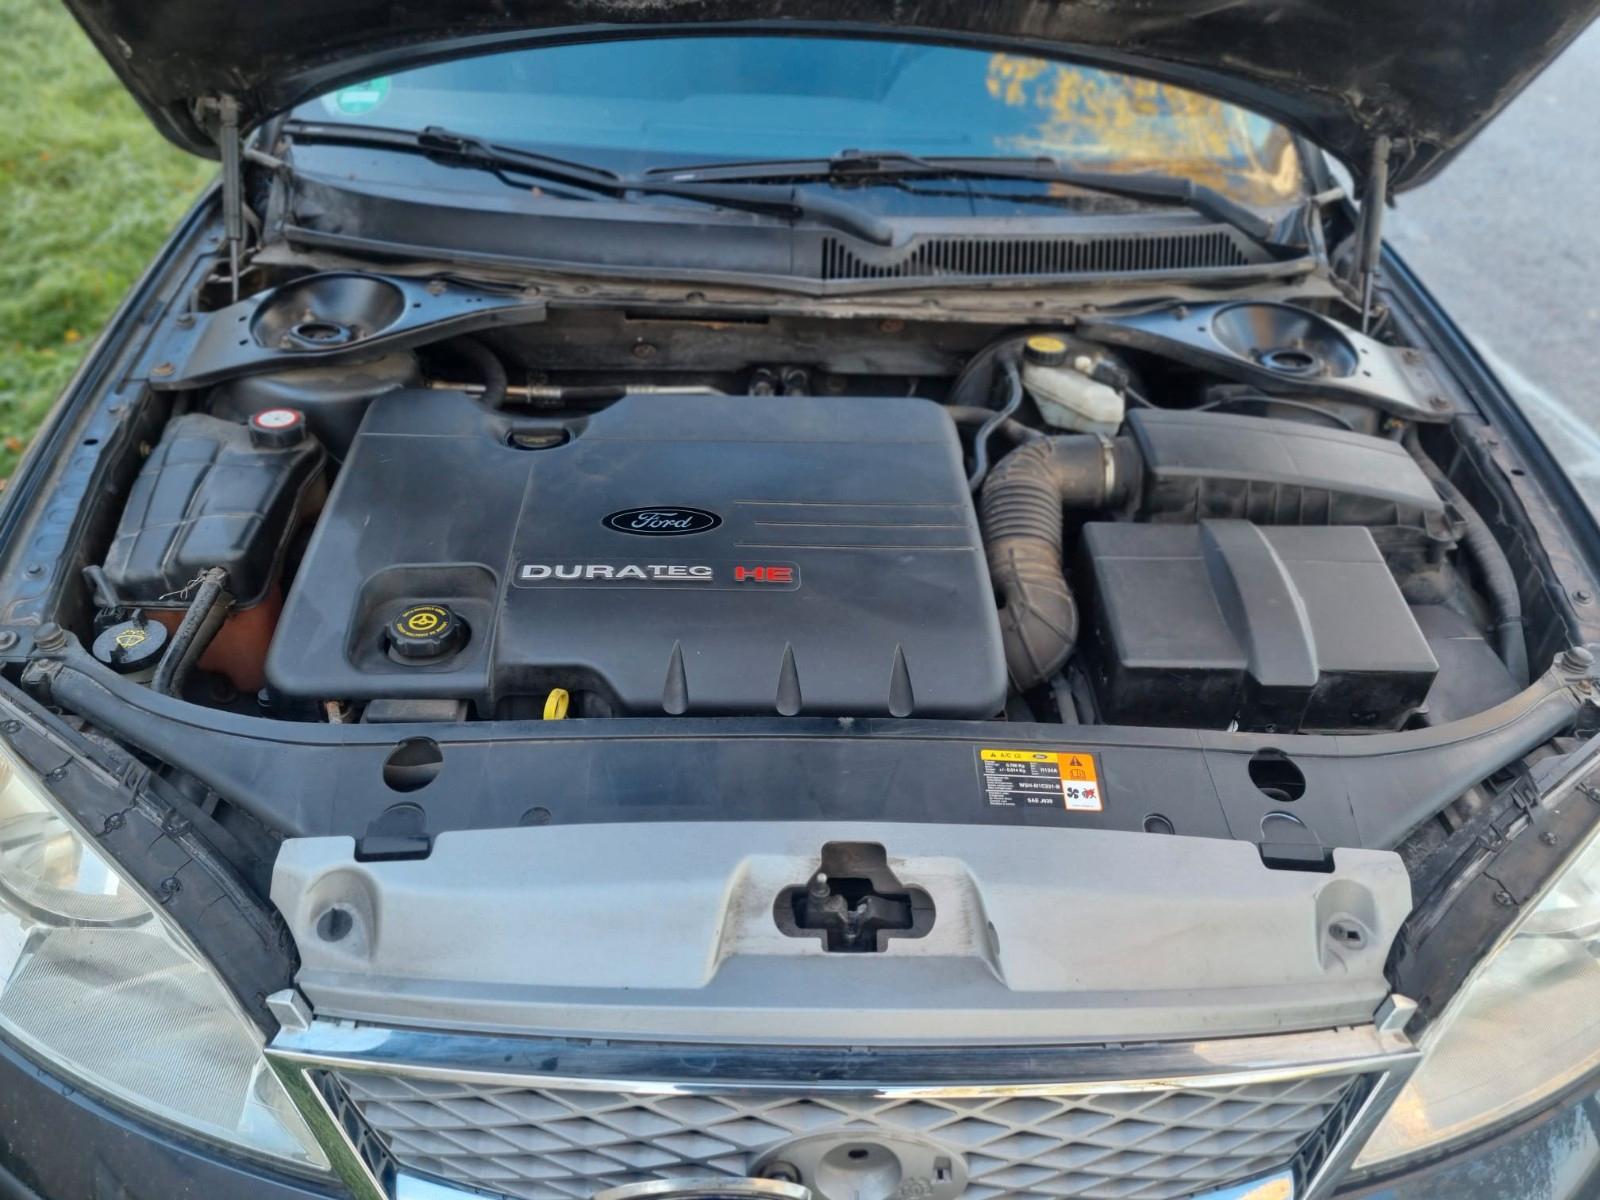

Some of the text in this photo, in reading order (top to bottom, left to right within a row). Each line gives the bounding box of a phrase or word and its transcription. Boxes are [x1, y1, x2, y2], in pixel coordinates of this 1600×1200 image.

[631, 511, 694, 530] Ford
[521, 563, 793, 582] DURATEC HE
